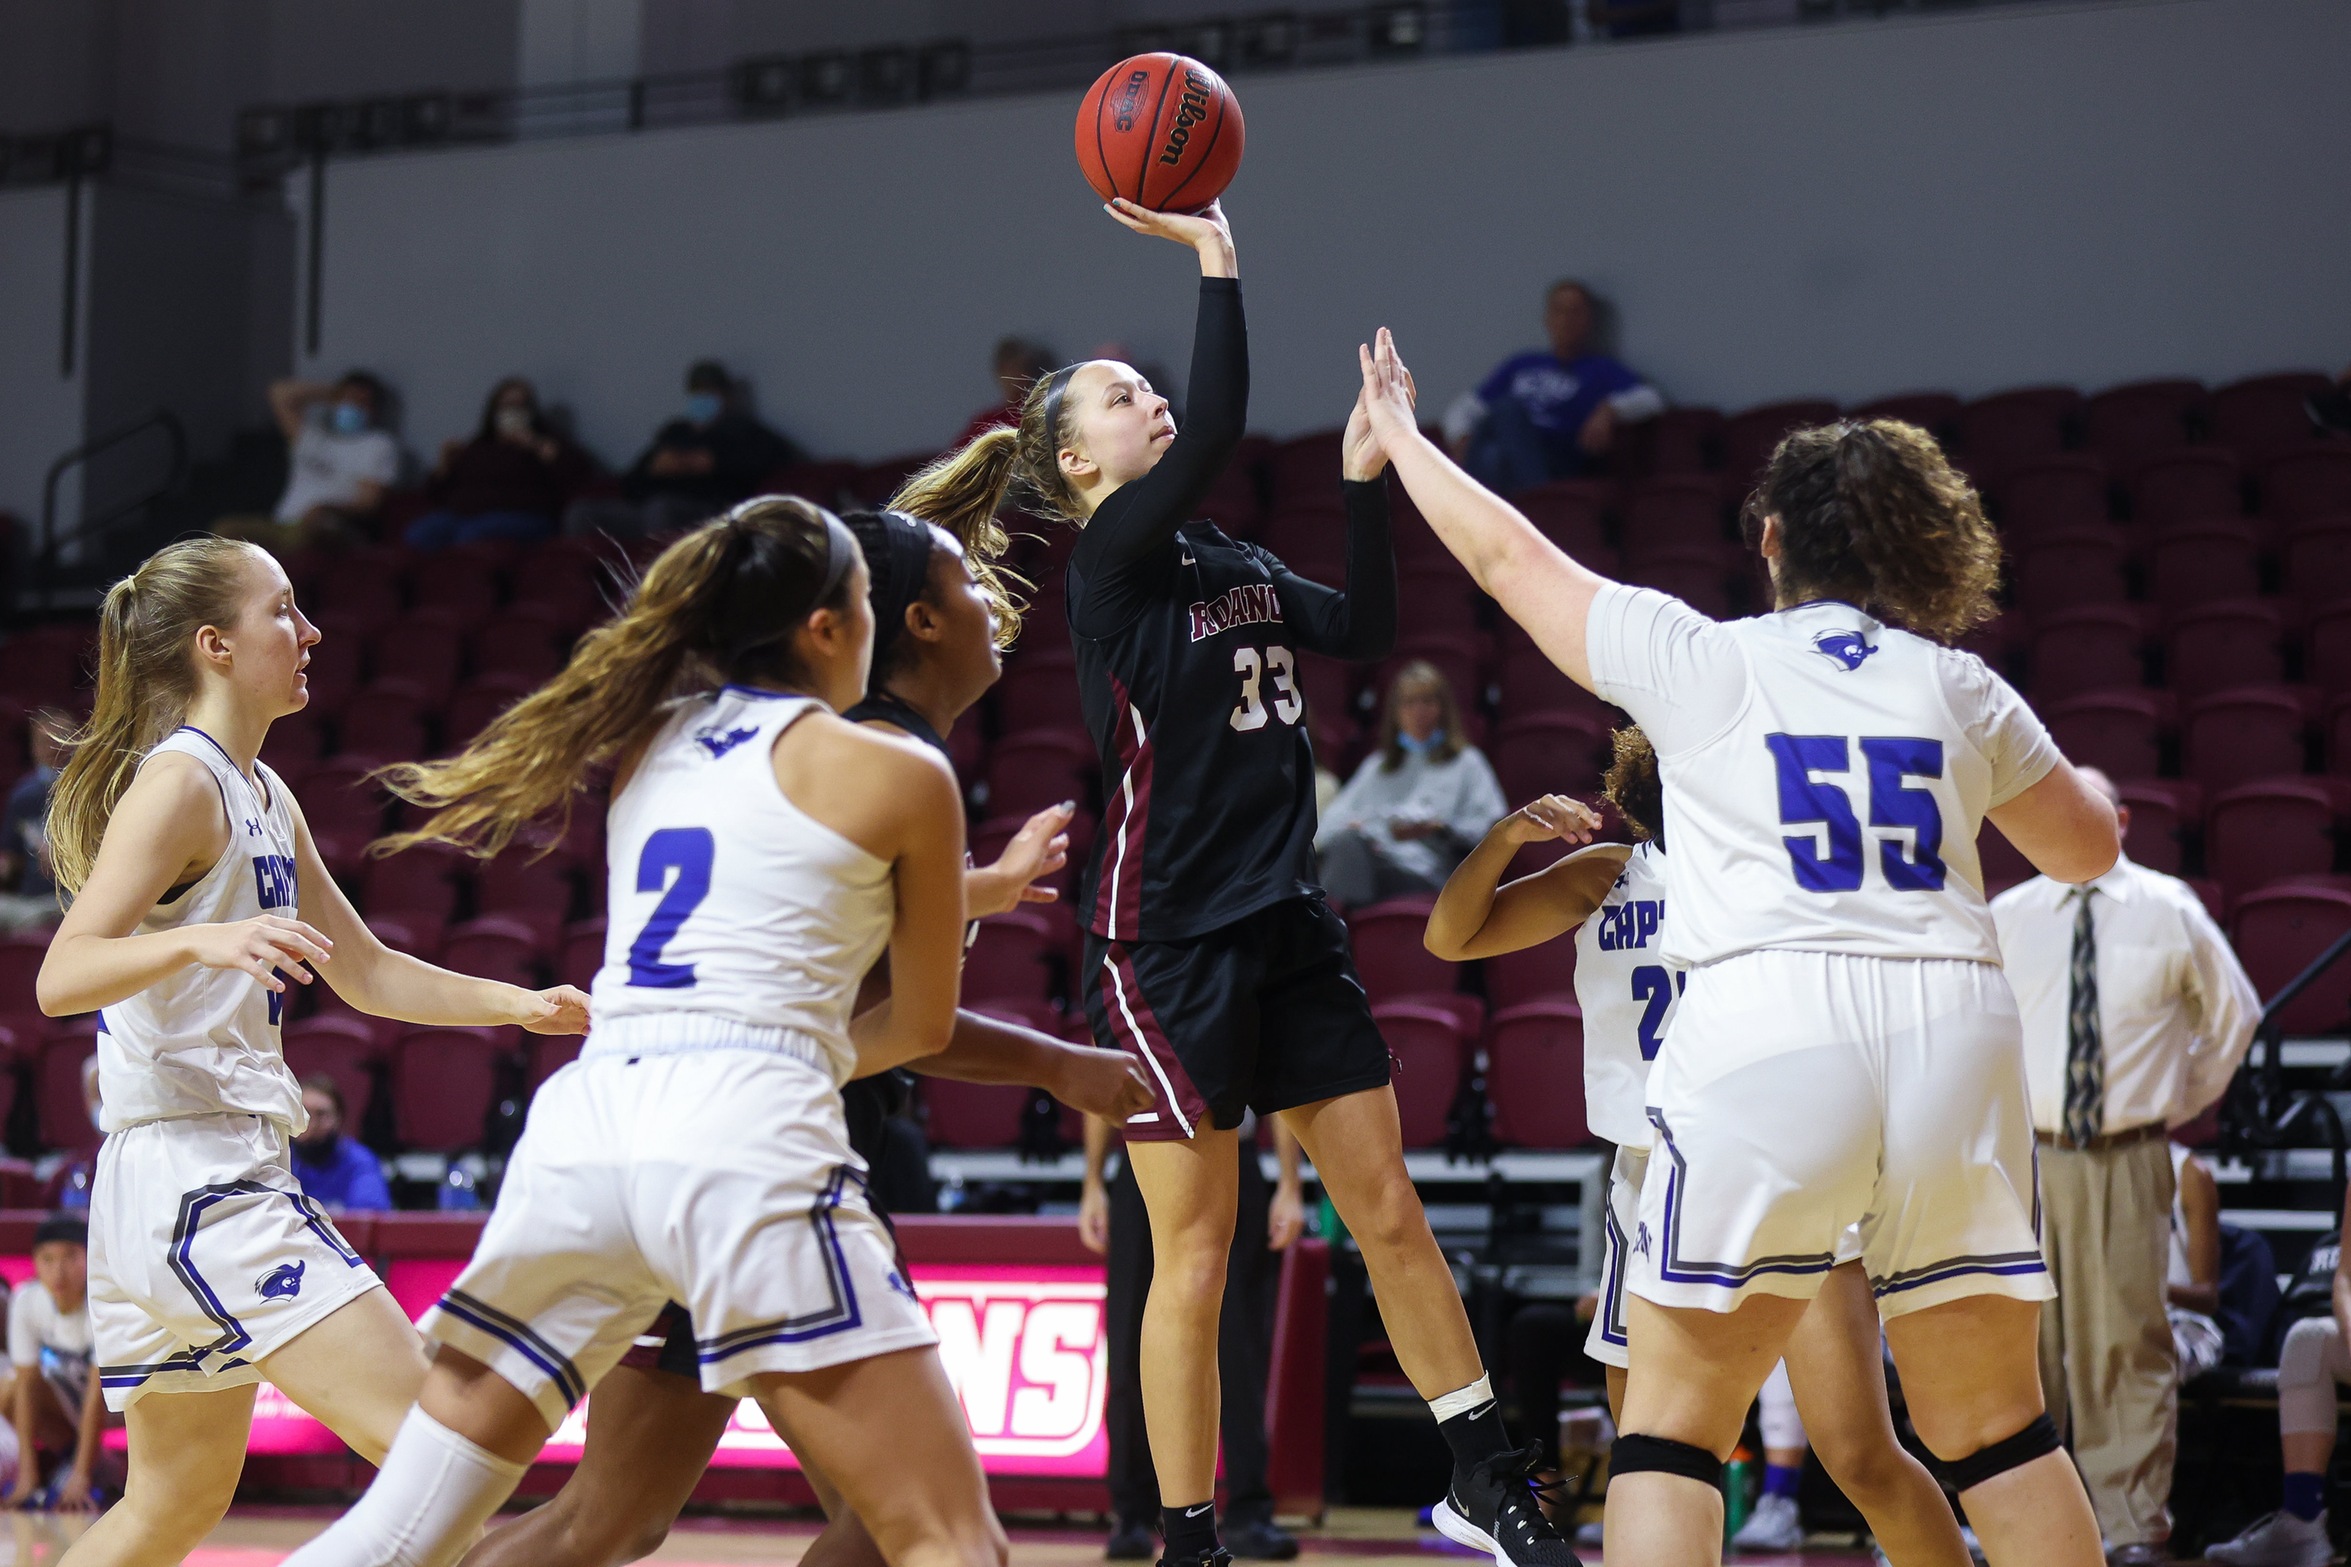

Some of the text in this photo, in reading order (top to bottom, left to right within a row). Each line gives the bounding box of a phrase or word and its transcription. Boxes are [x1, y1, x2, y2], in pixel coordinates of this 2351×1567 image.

[1158, 68, 1212, 168] Wilson
[1229, 645, 1303, 732] 33
[1764, 731, 1947, 893] 55
[625, 826, 715, 988] 2
[1598, 899, 1665, 951] CAP
[1631, 965, 1686, 1061] 2
